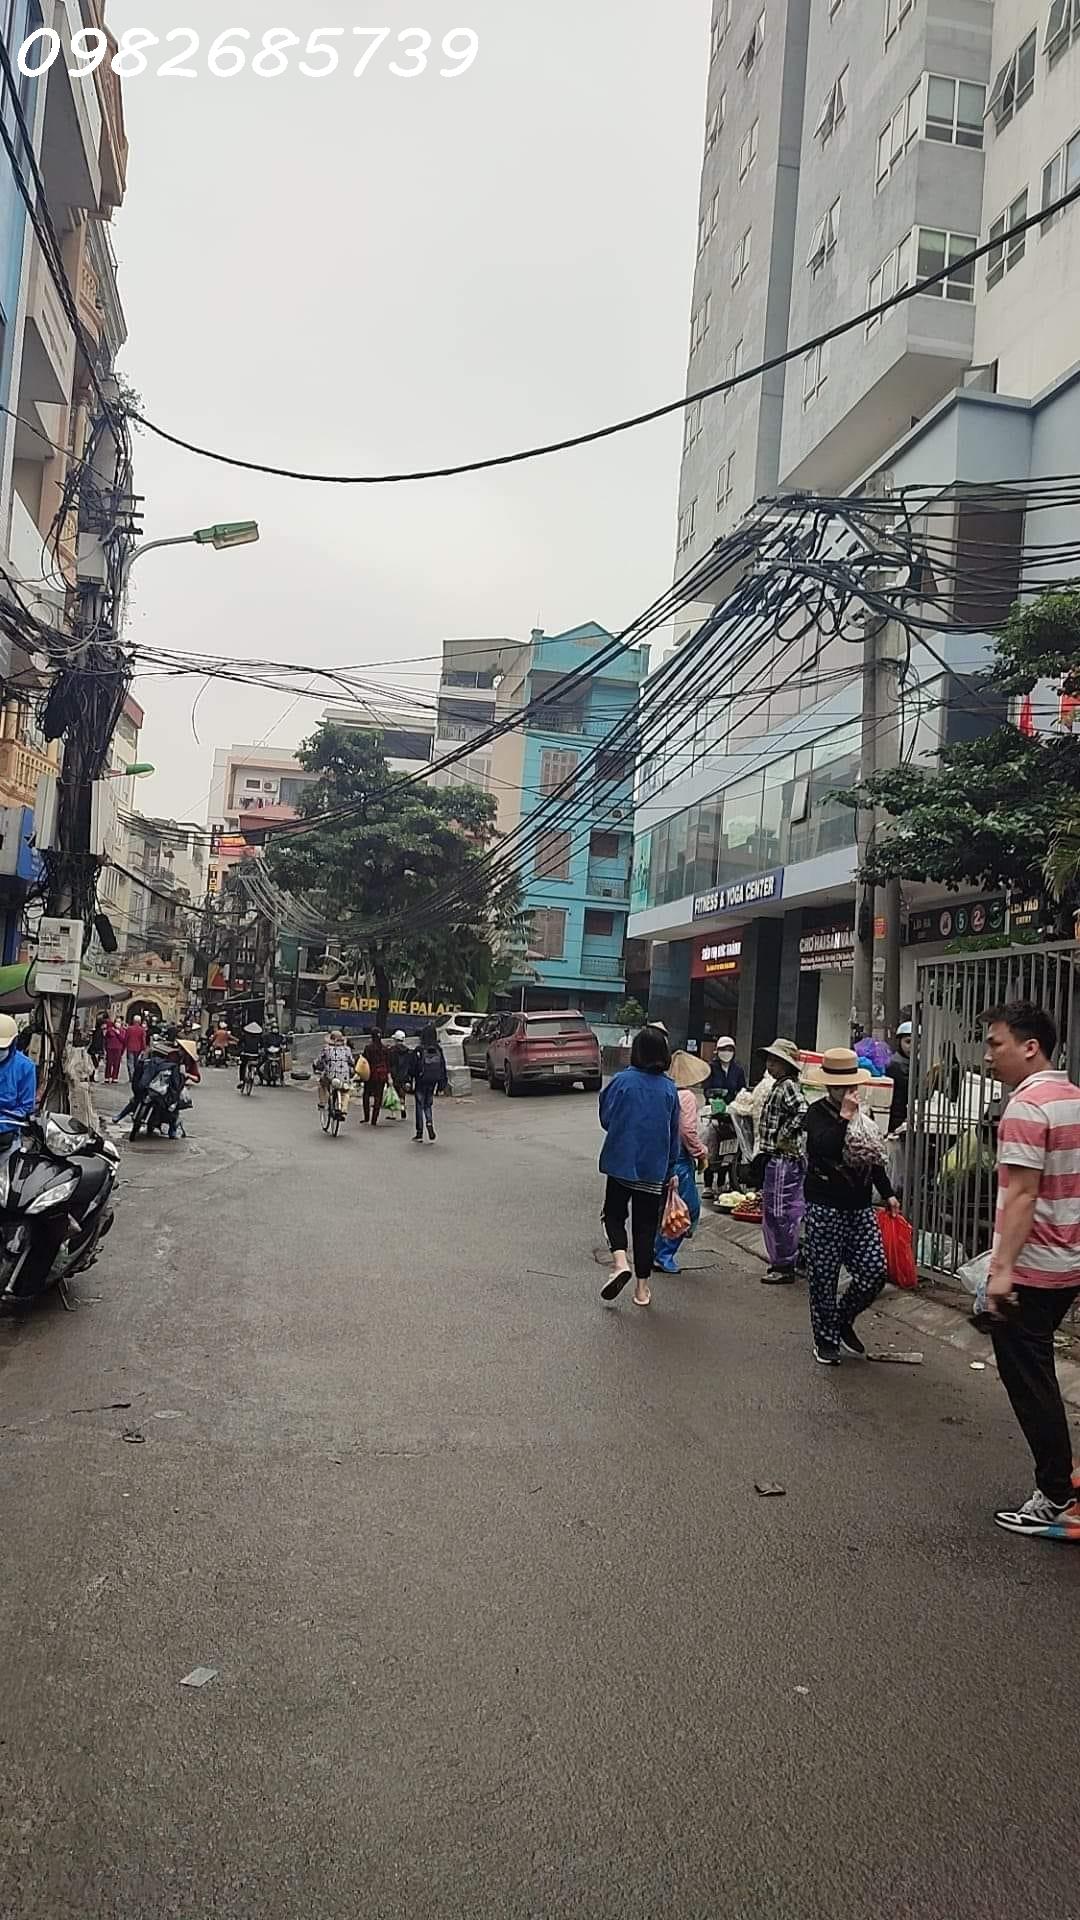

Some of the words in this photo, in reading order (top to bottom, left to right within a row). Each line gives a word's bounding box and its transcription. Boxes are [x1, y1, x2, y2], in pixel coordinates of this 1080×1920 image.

[694, 893, 719, 914] FITNESS
[719, 893, 725, 909] &
[726, 887, 744, 907] YOGA
[745, 876, 775, 899] CENTER
